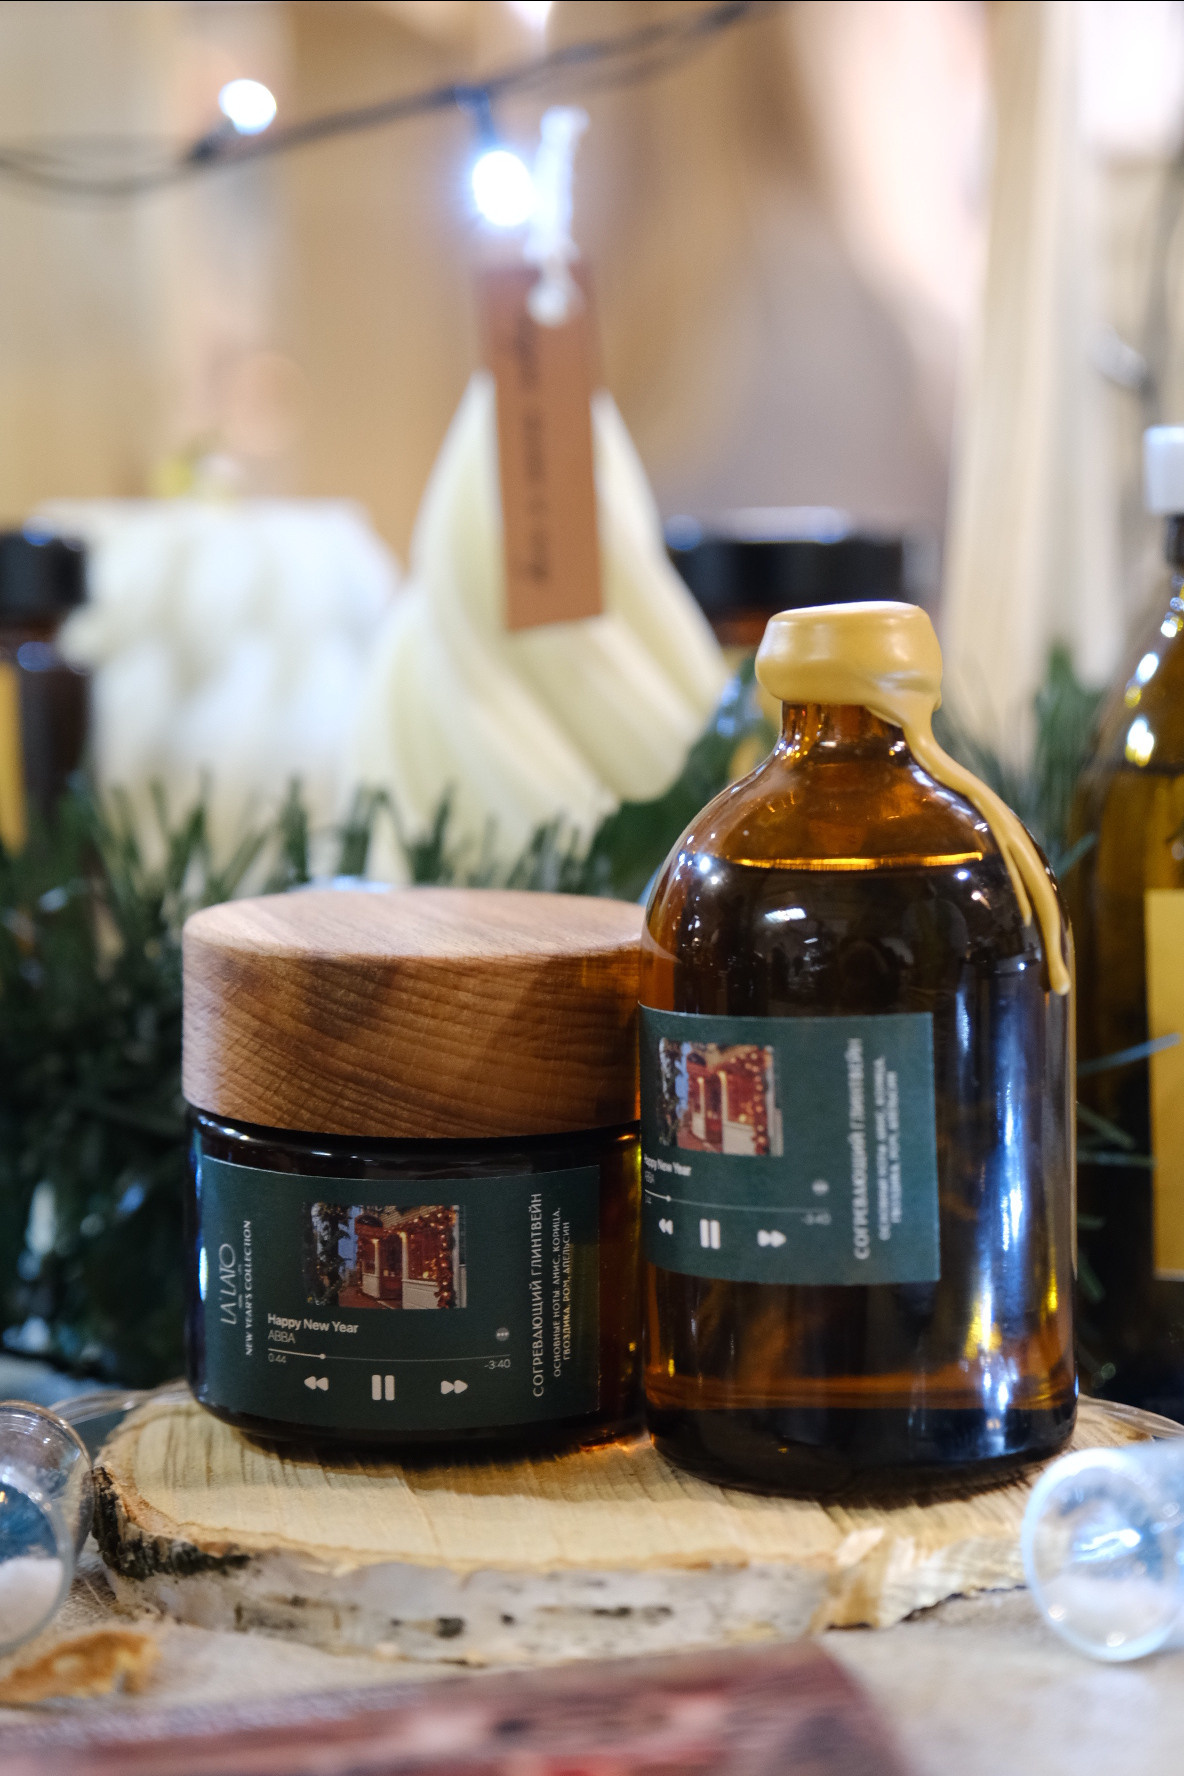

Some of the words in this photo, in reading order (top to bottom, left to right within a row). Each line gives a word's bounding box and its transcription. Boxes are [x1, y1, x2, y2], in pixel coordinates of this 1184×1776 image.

[528, 1193, 543, 1276] ГЛИНТВЕЙН
[552, 1207, 561, 1252] КОРИЦА,
[562, 1221, 571, 1274] АПЕЛЬСИН
[243, 1220, 252, 1291] COLLECTION
[552, 1254, 561, 1285] АНИС,
[552, 1287, 561, 1318] НОТЫ:
[562, 1276, 571, 1302] РОМ,
[244, 1293, 253, 1329] YEAR'S
[267, 1313, 301, 1331] Happy
[303, 1318, 330, 1331] New
[331, 1321, 359, 1333] Year
[244, 1332, 253, 1356] NEW
[267, 1329, 296, 1344] ABBA
[529, 1280, 544, 1397] СОГРЕВАЮЩИЙ
[552, 1320, 561, 1377] ОСНОВНЫЕ
[562, 1304, 571, 1360] ГВОЗДИКА,
[484, 1358, 511, 1370] -3:40
